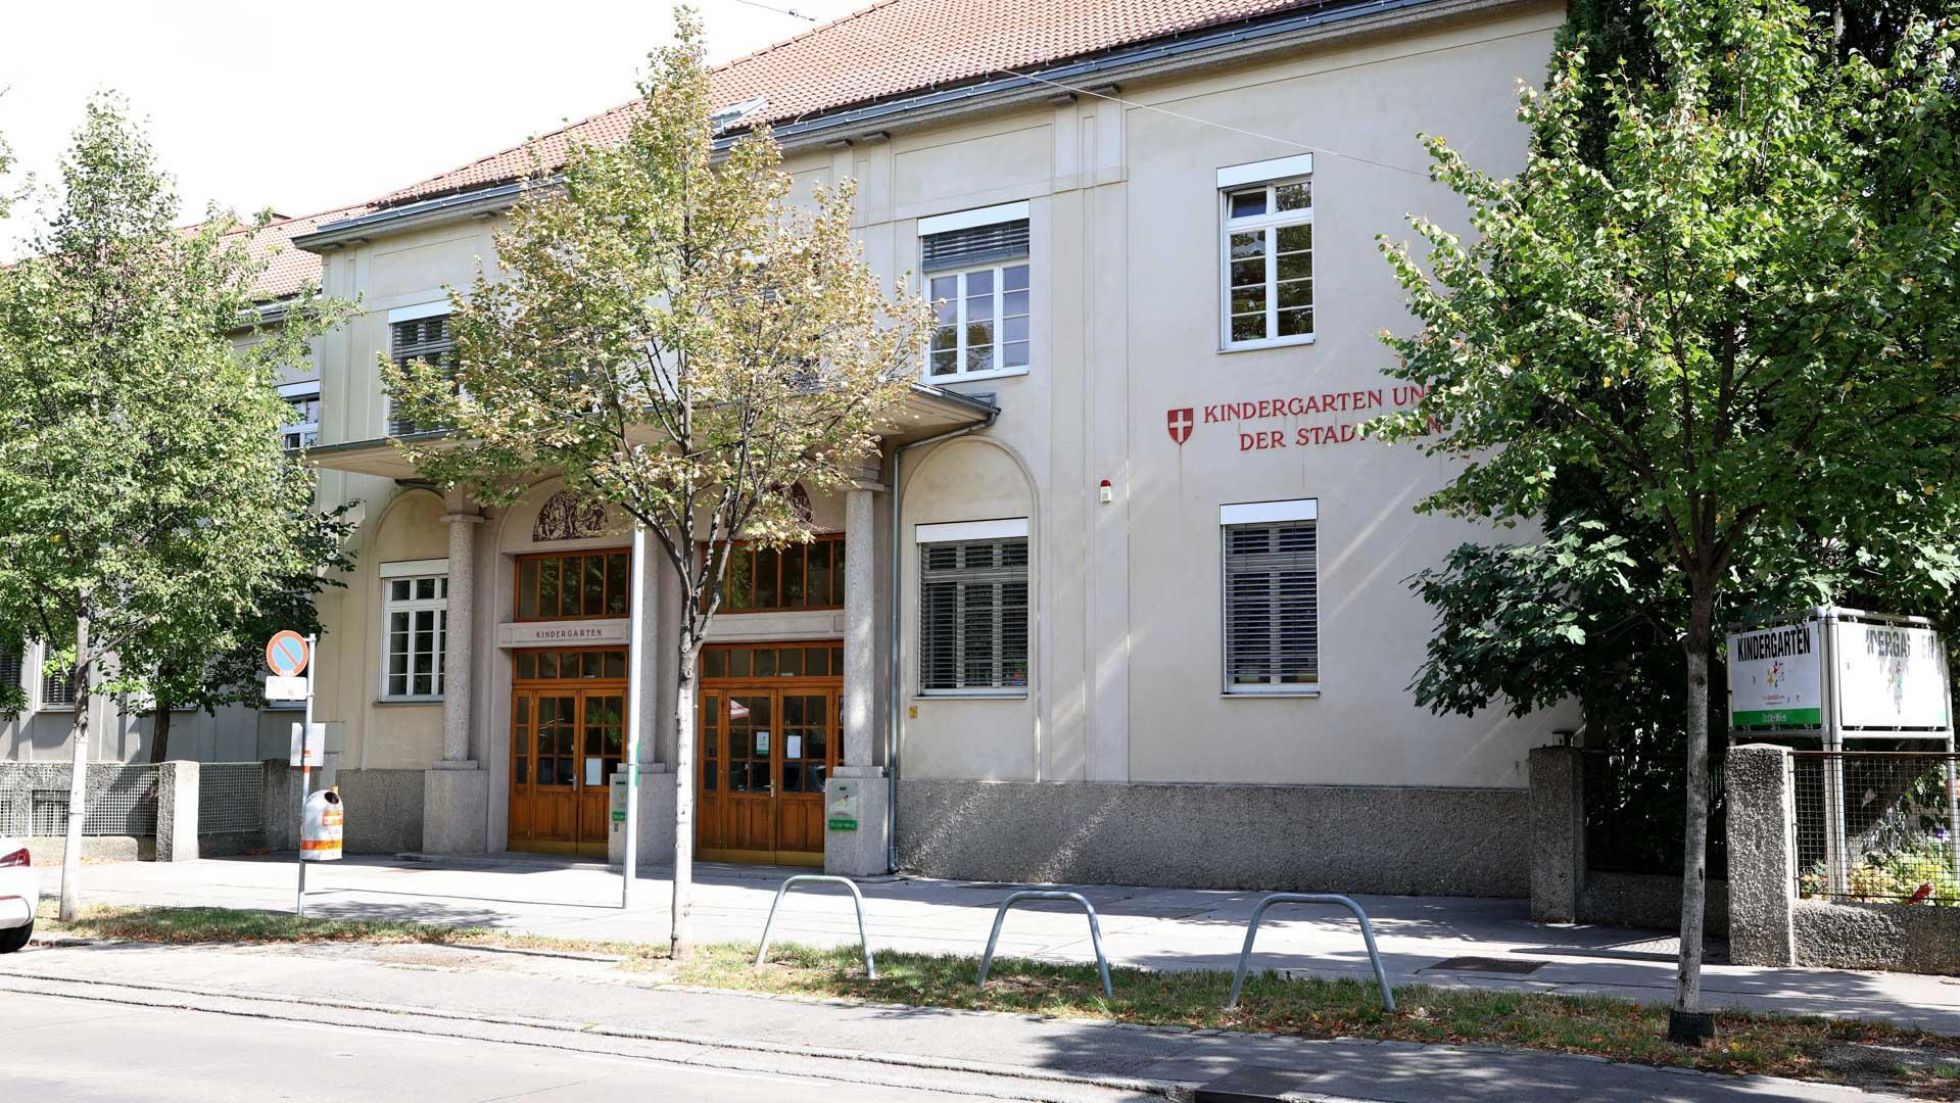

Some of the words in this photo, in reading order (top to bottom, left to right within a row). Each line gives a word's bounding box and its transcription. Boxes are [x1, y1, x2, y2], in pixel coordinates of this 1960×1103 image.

[1204, 389, 1383, 423] KINDERGARTEN
[1392, 385, 1433, 407] UN
[1239, 432, 1287, 451] DER
[1296, 424, 1366, 446] STAD
[536, 629, 602, 638] KINDERGARTEN
[1738, 627, 1810, 662] KINDERGARTEN
